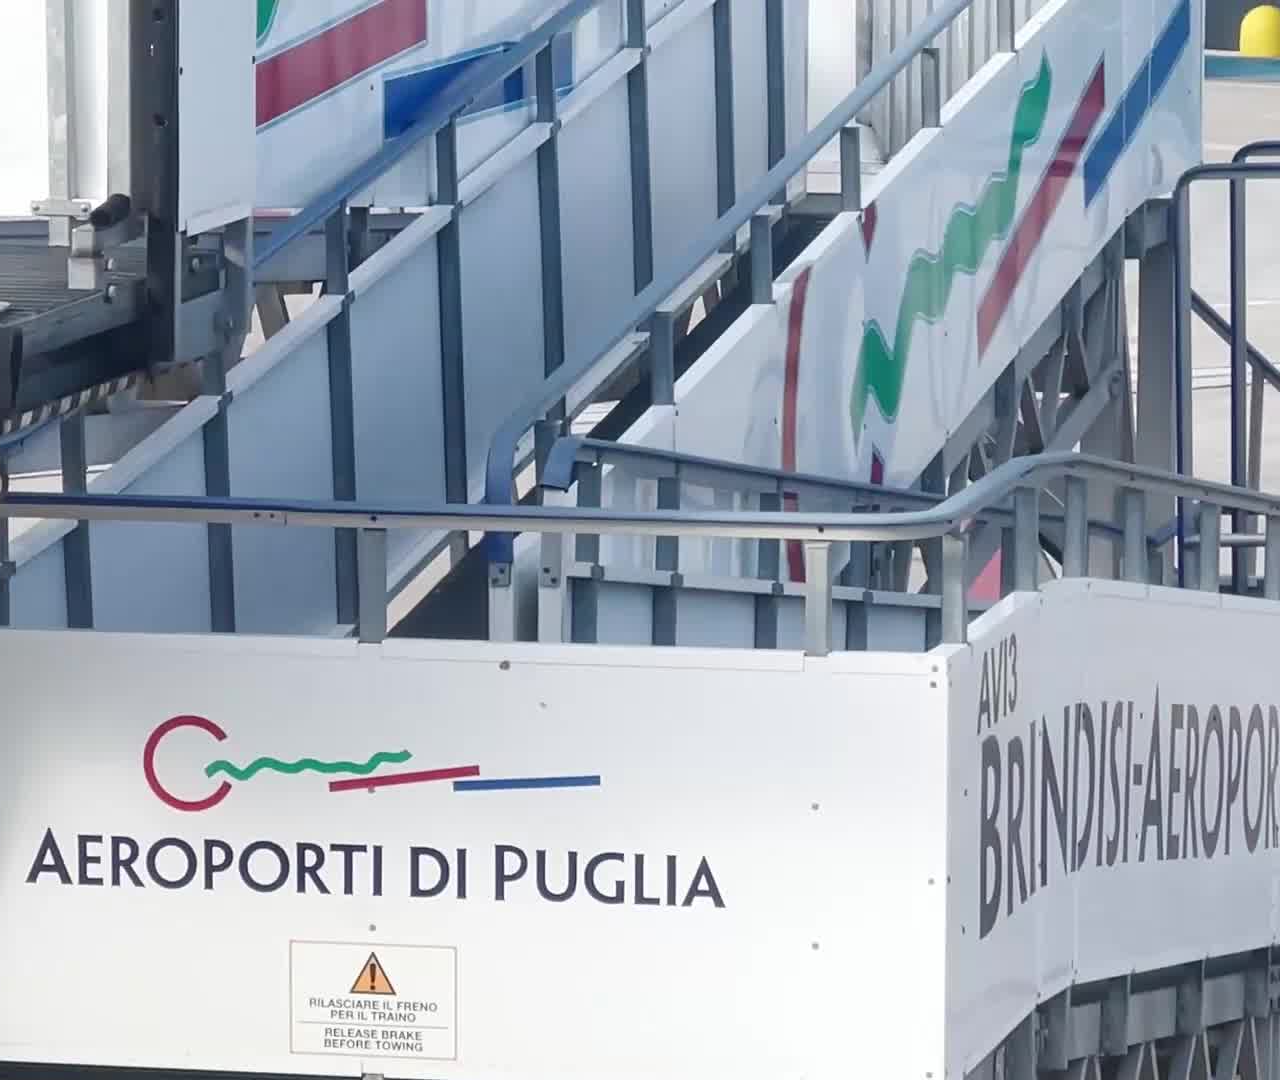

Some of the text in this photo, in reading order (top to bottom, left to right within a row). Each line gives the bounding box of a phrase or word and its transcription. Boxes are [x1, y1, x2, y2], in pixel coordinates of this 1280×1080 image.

[25, 826, 726, 908] AEROPORTI DI PUGLIA
[309, 997, 438, 1013] RILASCIARE IL FRENO
[330, 1009, 417, 1023] PER IL TRAINO
[324, 1027, 423, 1041] RELEASE BRAKE
[324, 1038, 424, 1052] BEFORE TOWING
